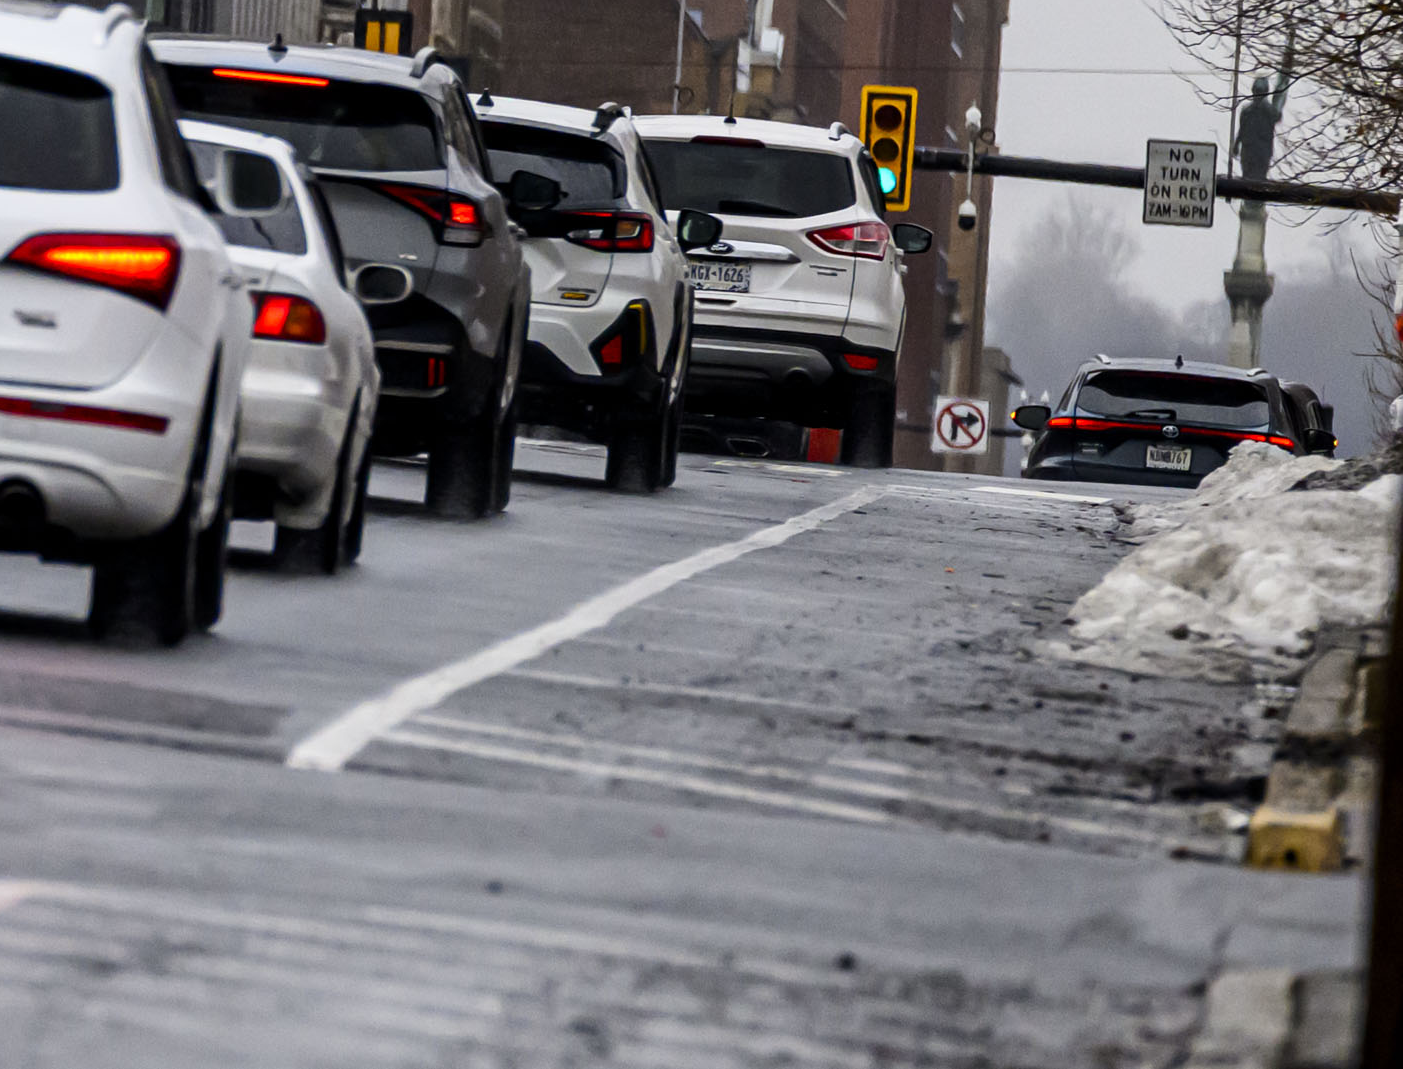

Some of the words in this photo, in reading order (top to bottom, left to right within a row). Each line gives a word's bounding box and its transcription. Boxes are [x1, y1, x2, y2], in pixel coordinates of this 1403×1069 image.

[1169, 147, 1195, 164] NO
[1161, 165, 1201, 183] TURN
[1150, 184, 1171, 199] ON
[1178, 185, 1209, 202] RED
